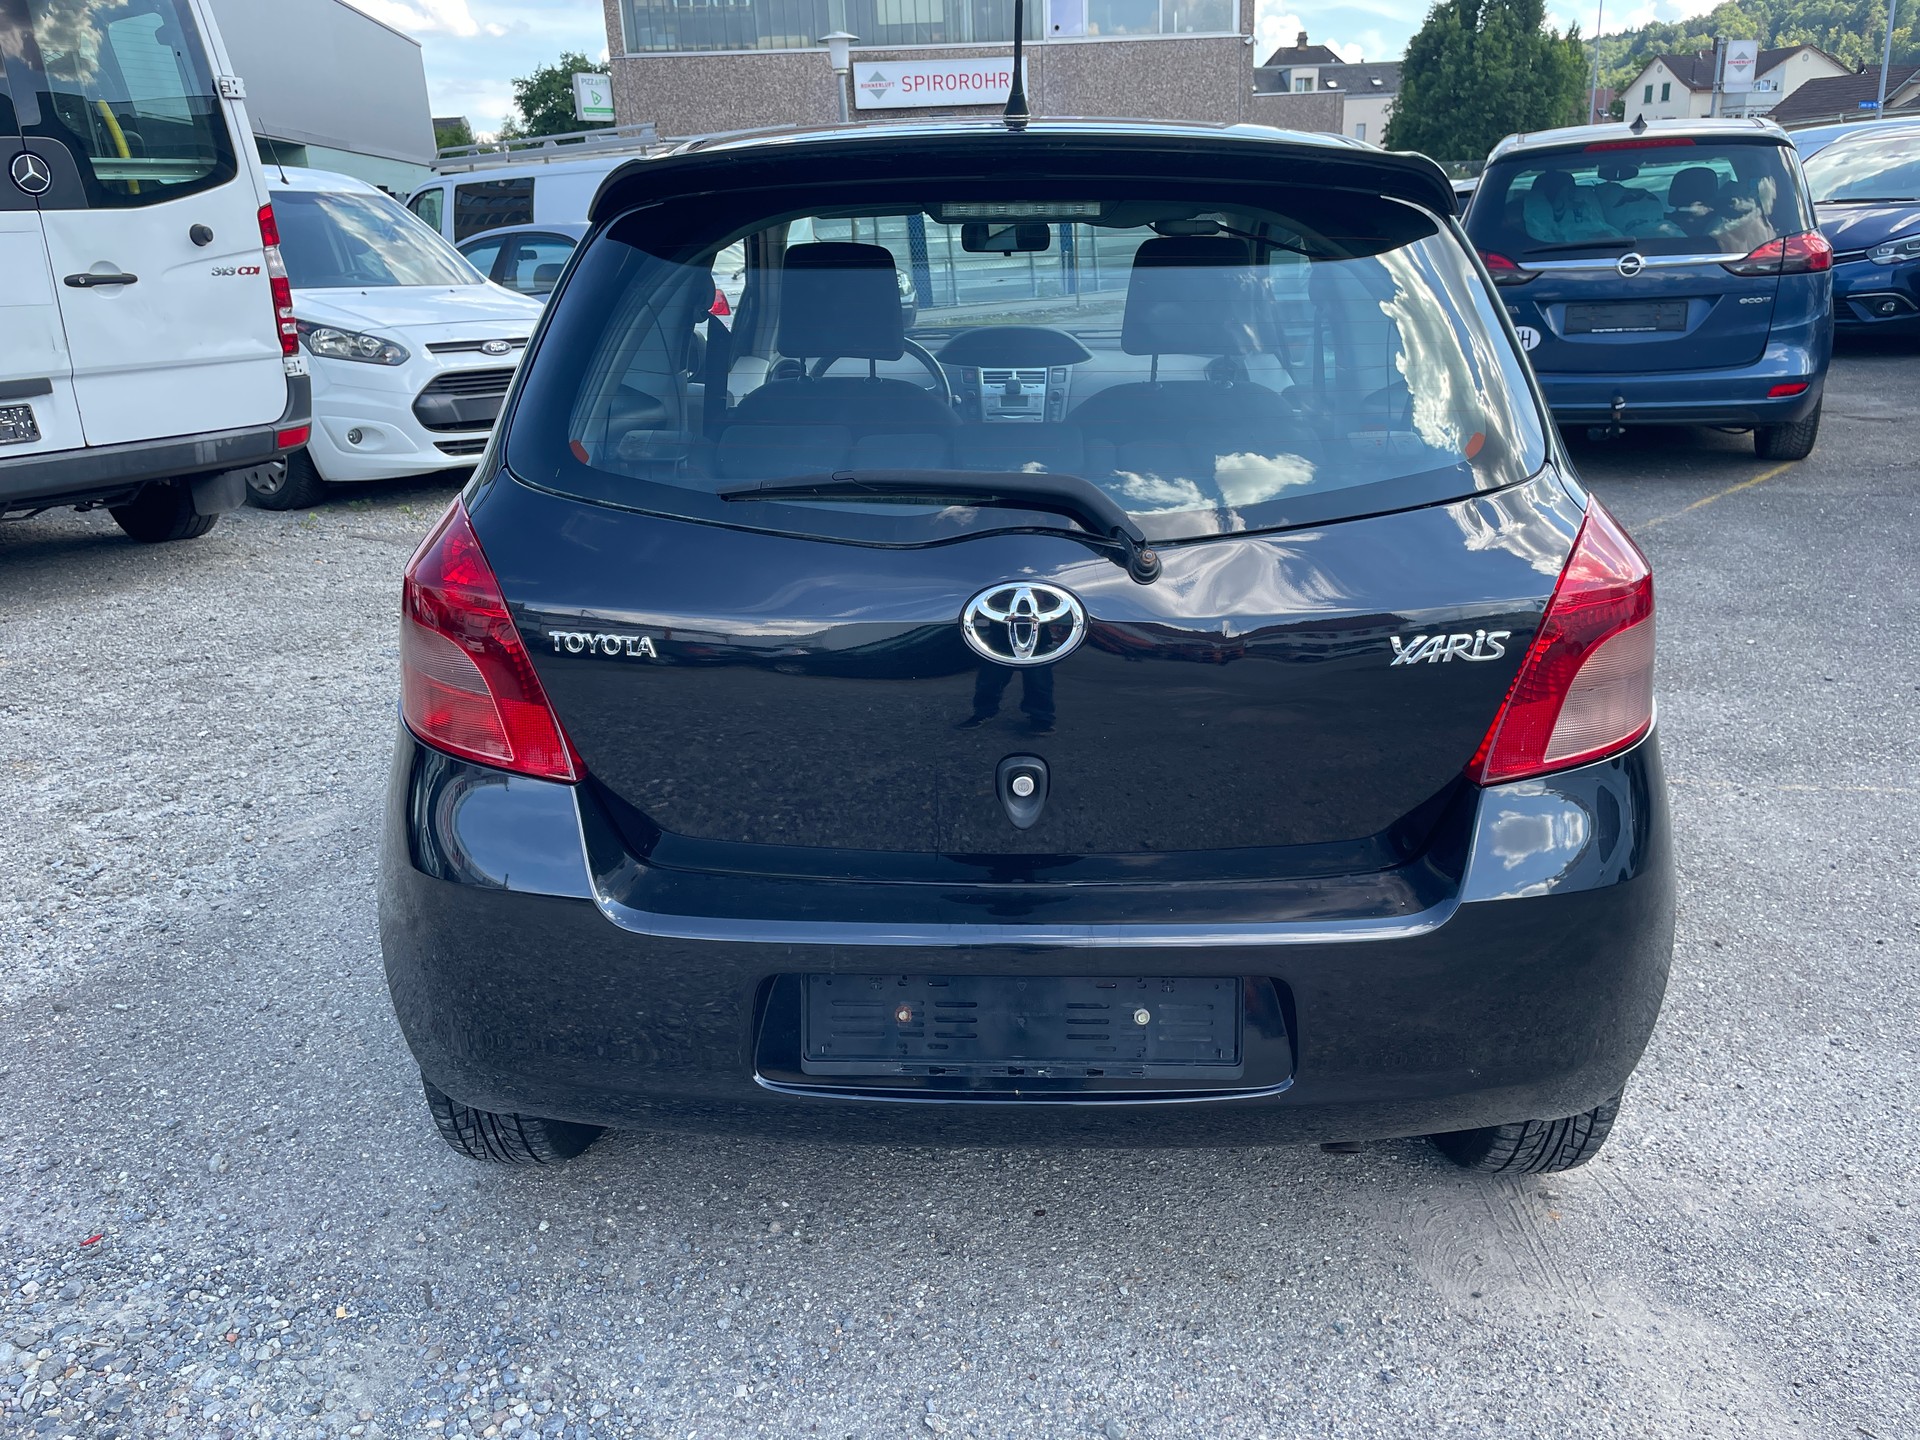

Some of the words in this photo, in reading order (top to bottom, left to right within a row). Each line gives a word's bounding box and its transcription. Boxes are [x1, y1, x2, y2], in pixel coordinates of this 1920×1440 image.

[902, 72, 1014, 93] SPIROROHR
[237, 266, 260, 275] CDI
[549, 630, 657, 658] TOYOTA
